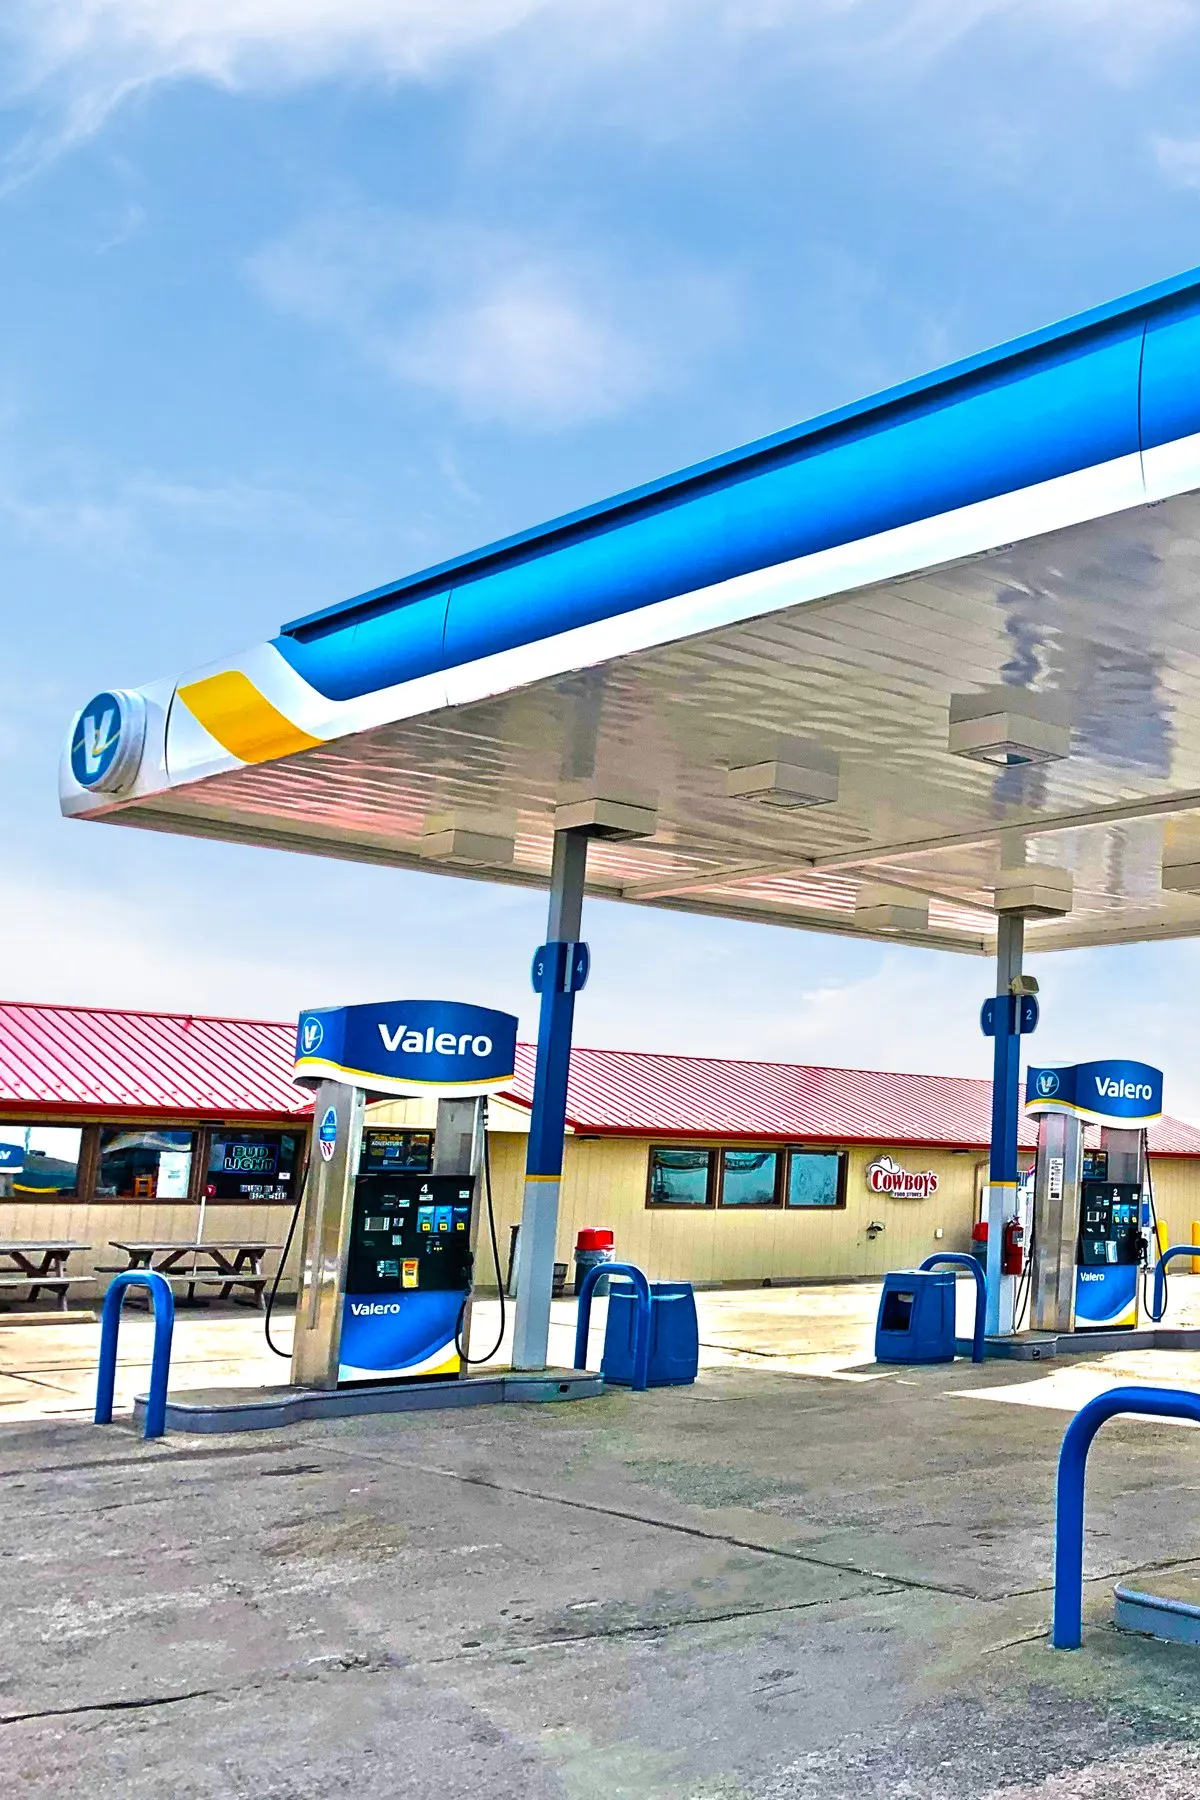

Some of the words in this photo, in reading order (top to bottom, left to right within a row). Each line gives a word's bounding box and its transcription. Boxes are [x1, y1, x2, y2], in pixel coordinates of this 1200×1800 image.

[537, 962, 544, 976] 3
[577, 960, 583, 973] 4
[987, 1012, 993, 1023] 1
[1026, 1009, 1032, 1020] 2
[378, 1024, 493, 1057] Valero
[1095, 1076, 1152, 1100] Valero
[232, 1146, 268, 1158] BUD
[225, 1157, 275, 1170] LIGHT
[420, 1184, 428, 1193] 4
[1113, 1188, 1118, 1196] 2
[1080, 1272, 1105, 1282] Valero
[351, 1303, 400, 1316] Valero
